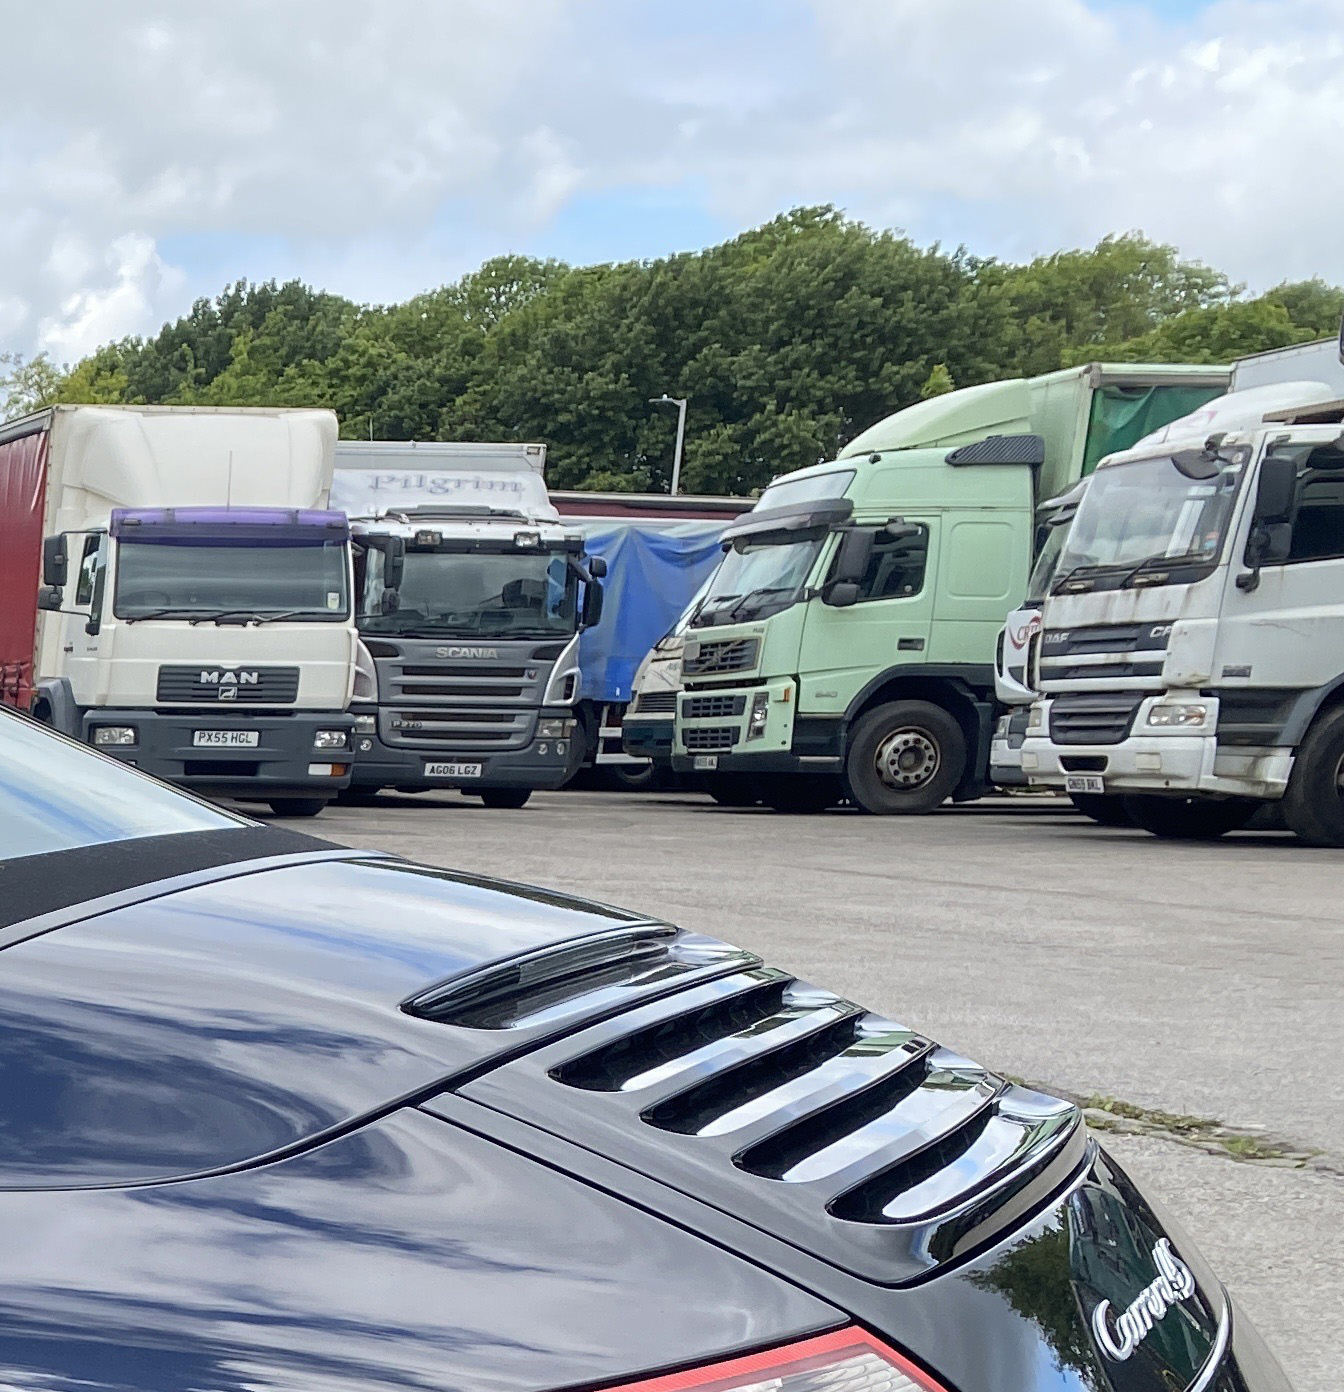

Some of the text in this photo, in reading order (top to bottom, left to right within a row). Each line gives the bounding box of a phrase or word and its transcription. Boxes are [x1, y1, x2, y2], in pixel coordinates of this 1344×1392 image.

[368, 474, 525, 496] Pilgrim
[1043, 632, 1070, 643] DAF
[436, 647, 498, 659] SCANIA
[200, 671, 258, 684] MAN
[198, 731, 253, 744] PX55 HGL
[429, 765, 478, 775] AG06 LGZ
